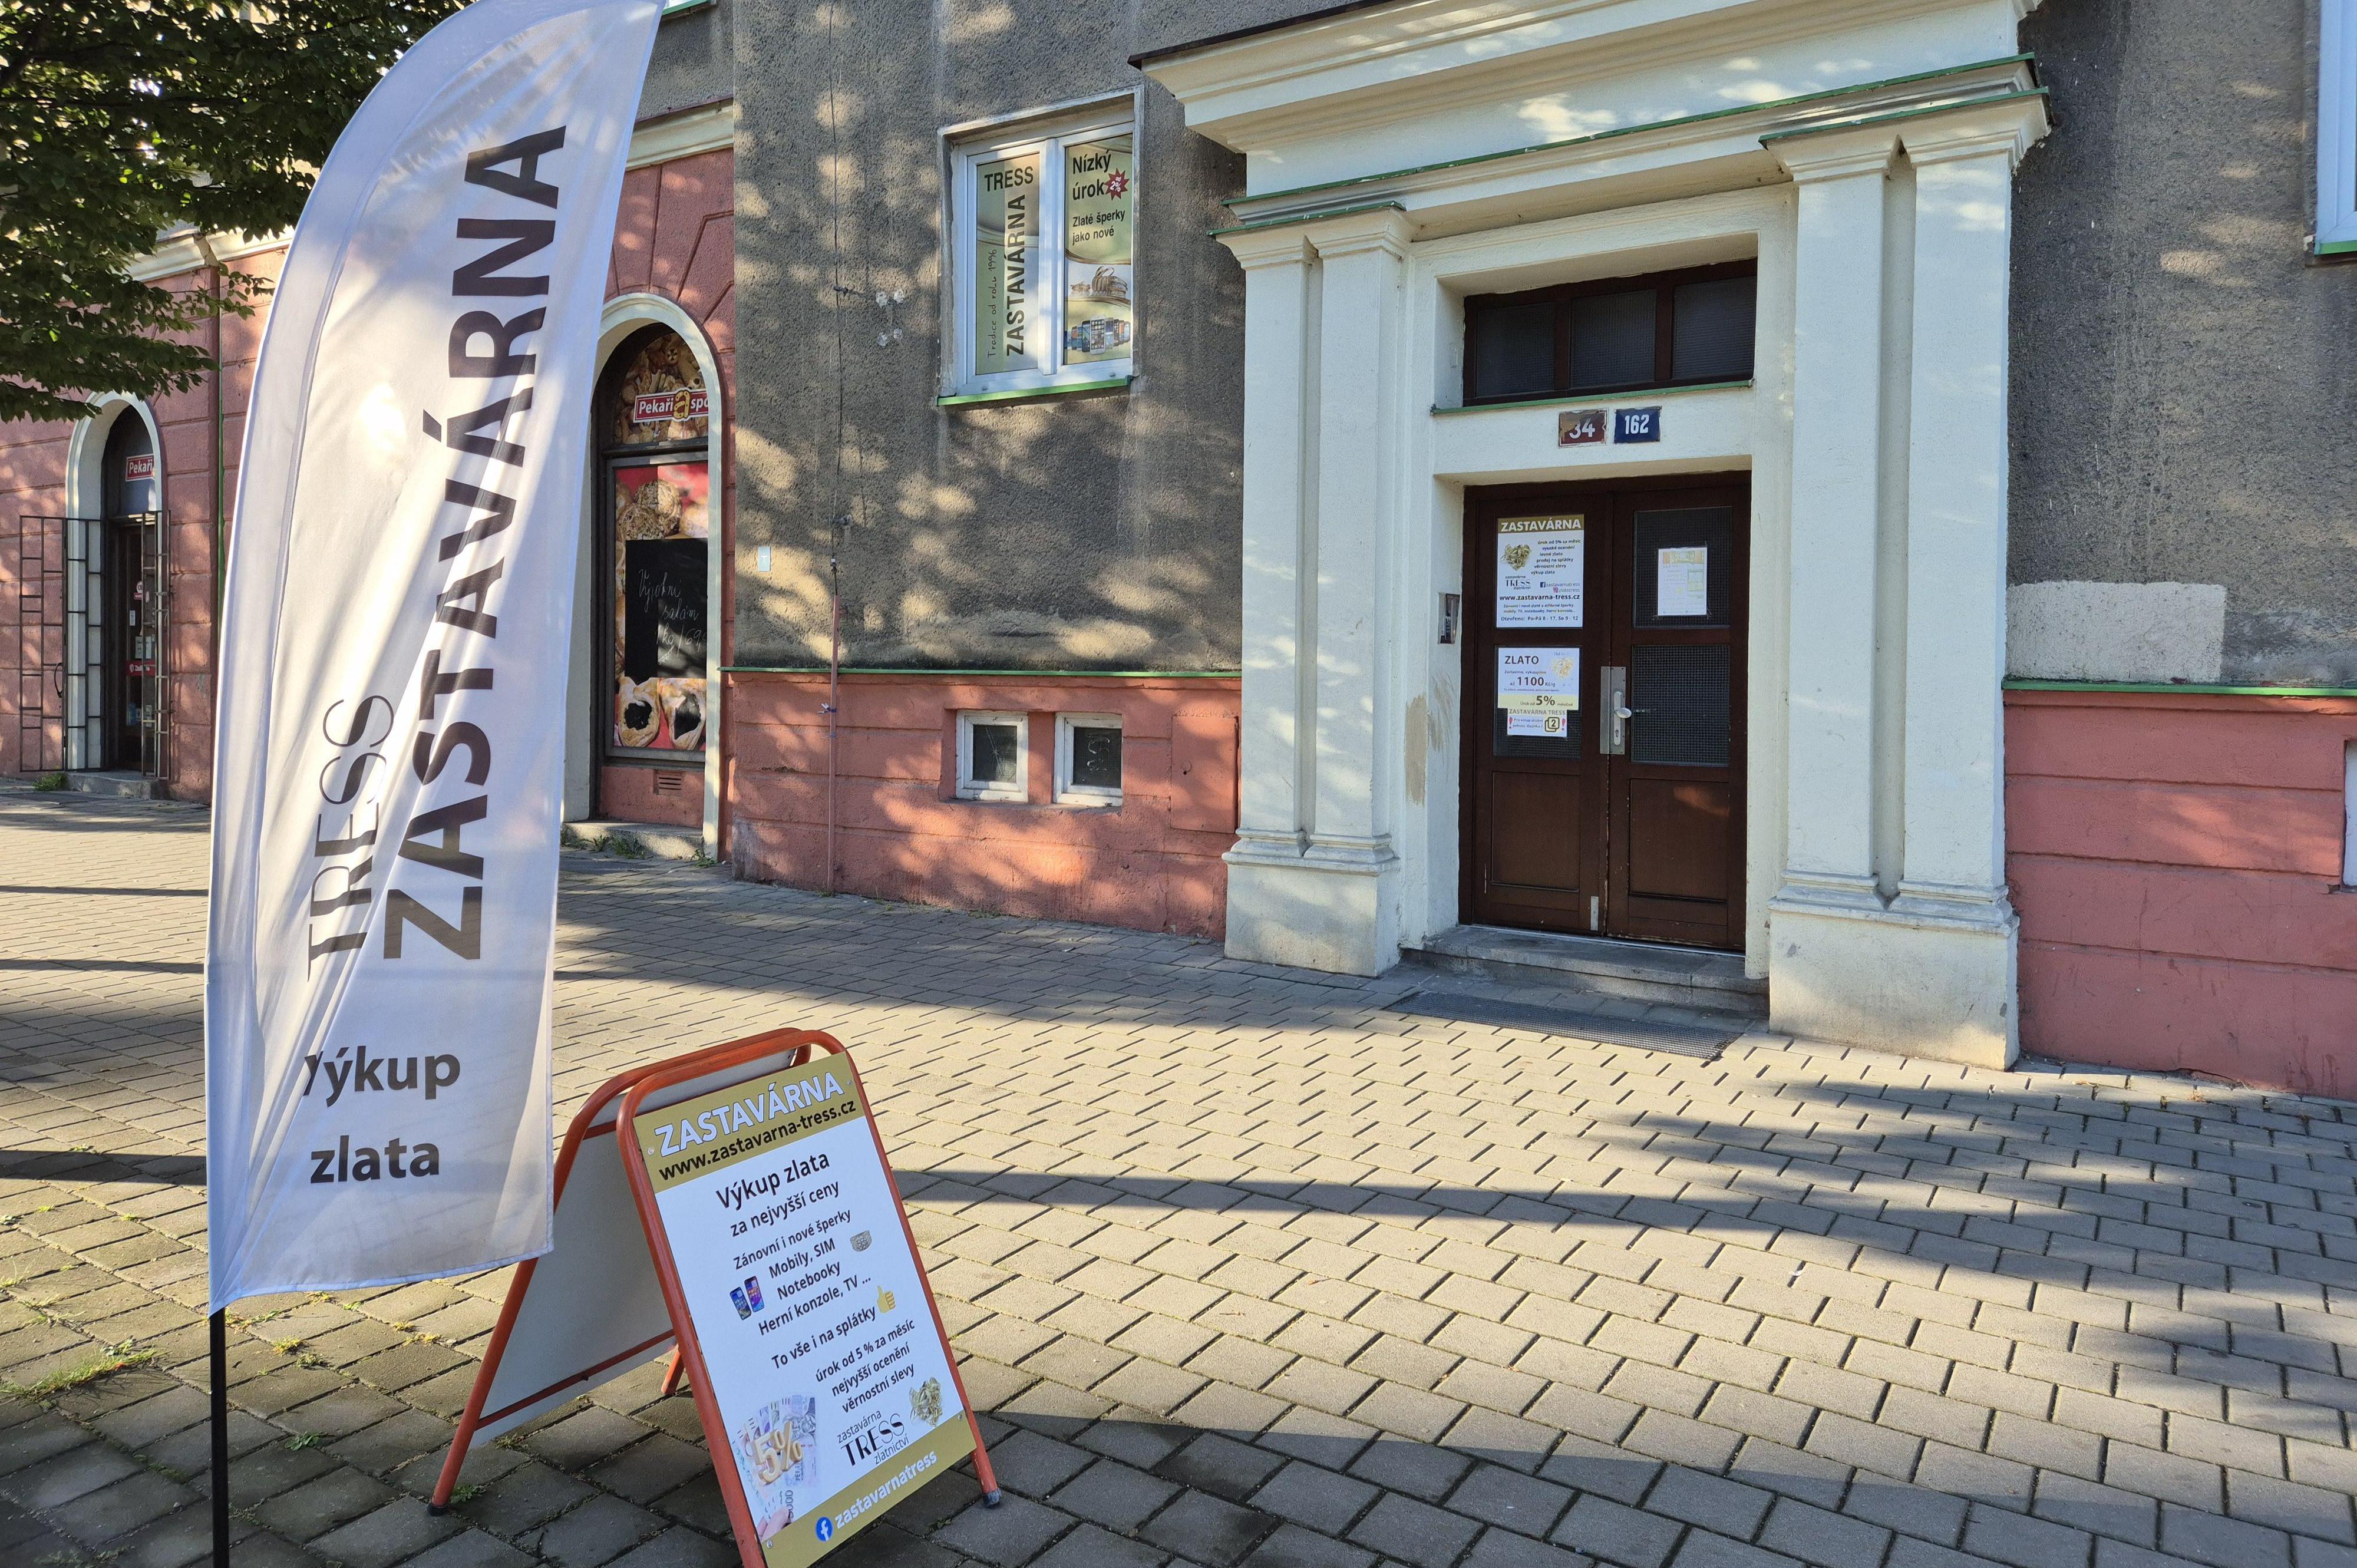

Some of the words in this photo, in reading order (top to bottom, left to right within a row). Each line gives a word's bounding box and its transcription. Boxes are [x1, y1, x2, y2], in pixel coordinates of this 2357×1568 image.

[985, 166, 1034, 192] TRESS
[1072, 150, 1112, 174] Nízký
[1072, 179, 1105, 201] úrok
[1110, 181, 1121, 192] 2%
[1072, 213, 1094, 227] Zlaté
[1096, 209, 1125, 225] šperky
[1072, 231, 1090, 246] jako
[1093, 225, 1114, 239] nové
[988, 249, 998, 272] 1996
[1004, 194, 1026, 356] ZASTAVÁRNA
[988, 304, 997, 315] od
[988, 321, 997, 358] Tradice
[639, 397, 674, 414] Pekaři
[673, 390, 691, 419] a
[1569, 417, 1596, 439] 34
[1625, 414, 1650, 435] 162
[128, 458, 153, 474] Pekaři
[1500, 517, 1582, 532] ZASTAVÁRNA
[383, 125, 566, 960] ZASTAVÁRNA
[661, 598, 699, 620] salám
[1504, 655, 1539, 665] ZLATO
[1517, 676, 1544, 686] 1100
[1536, 695, 1555, 706] 5%
[1550, 719, 1556, 728] 2
[307, 695, 394, 982] TRESS
[655, 1071, 844, 1157] ZASTAVÁRNA
[658, 1100, 856, 1181] www.zastavarna-tress.cz
[311, 1135, 440, 1184] zlata
[715, 1172, 781, 1211] Výkup
[783, 1153, 830, 1184] zlata
[730, 1220, 748, 1237] za
[750, 1190, 807, 1226] nejvyšší
[808, 1181, 840, 1203] ceny
[733, 1238, 781, 1270] Zánovní
[781, 1236, 787, 1249] i
[788, 1223, 815, 1246] nové
[816, 1210, 851, 1234] šperky
[768, 1250, 813, 1279] Mobily,
[814, 1238, 836, 1257] SIM
[777, 1261, 841, 1300] Notebooky
[758, 1306, 794, 1336] Herní
[794, 1287, 844, 1318] konzole,
[843, 1275, 858, 1292] TV
[771, 1355, 788, 1369] To
[790, 1341, 811, 1360] vše
[811, 1335, 818, 1349] i
[818, 1329, 834, 1345] na
[835, 1306, 876, 1336] splátky
[815, 1361, 841, 1382] úrok
[841, 1351, 856, 1368] od
[856, 1347, 863, 1360] 5
[863, 1341, 874, 1355] %
[874, 1336, 887, 1349] za
[887, 1319, 915, 1342] měsíc
[831, 1363, 872, 1397] nejvyšší
[873, 1341, 910, 1372] ocenění
[841, 1375, 890, 1414] věrnostní
[890, 1364, 915, 1385] slevy
[837, 1410, 882, 1444] zastavárna
[840, 1412, 905, 1467] TRESS
[754, 1420, 803, 1486] 5%
[873, 1433, 910, 1465] zlatnictví
[834, 1451, 938, 1530] zastavarnatress
